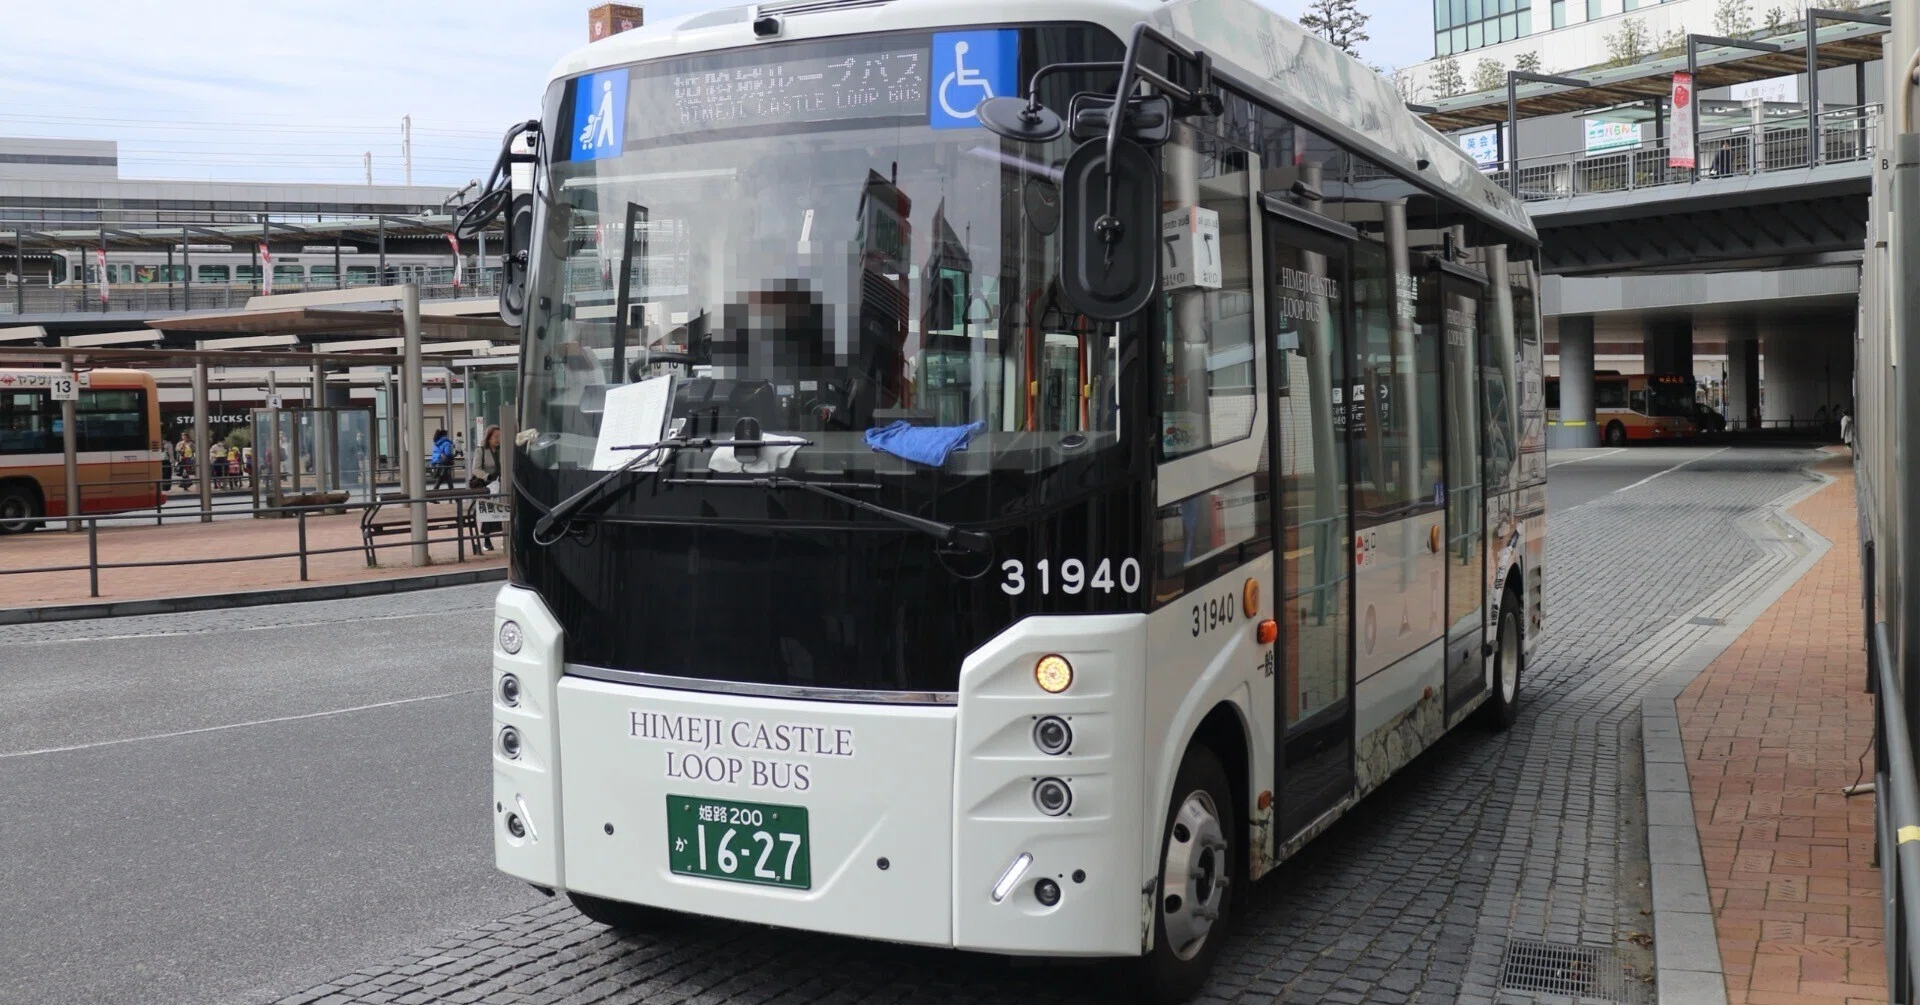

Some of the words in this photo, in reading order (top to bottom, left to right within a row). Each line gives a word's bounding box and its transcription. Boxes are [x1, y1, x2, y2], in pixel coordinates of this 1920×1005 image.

[679, 101, 746, 124] HIMEJI
[757, 92, 826, 116] CASTLE
[836, 87, 880, 108] LOOP
[888, 83, 922, 104] BUS
[1881, 158, 1889, 170] B
[1282, 267, 1309, 297] HIMEJI
[1309, 273, 1338, 299] CASTLE
[1283, 297, 1304, 319] LOOP
[1305, 301, 1320, 323] BUS
[55, 380, 71, 393] 13
[176, 415, 243, 424] STABUCKS
[1000, 557, 1141, 596] 31940
[1192, 592, 1234, 638] 31940
[1256, 650, 1274, 679] 一般
[630, 711, 723, 751] HIMEJI
[731, 721, 854, 756] CASTLE
[666, 751, 743, 784] LOOP
[751, 760, 810, 790] BUS
[675, 836, 688, 853] か
[697, 824, 801, 881] 16-27
